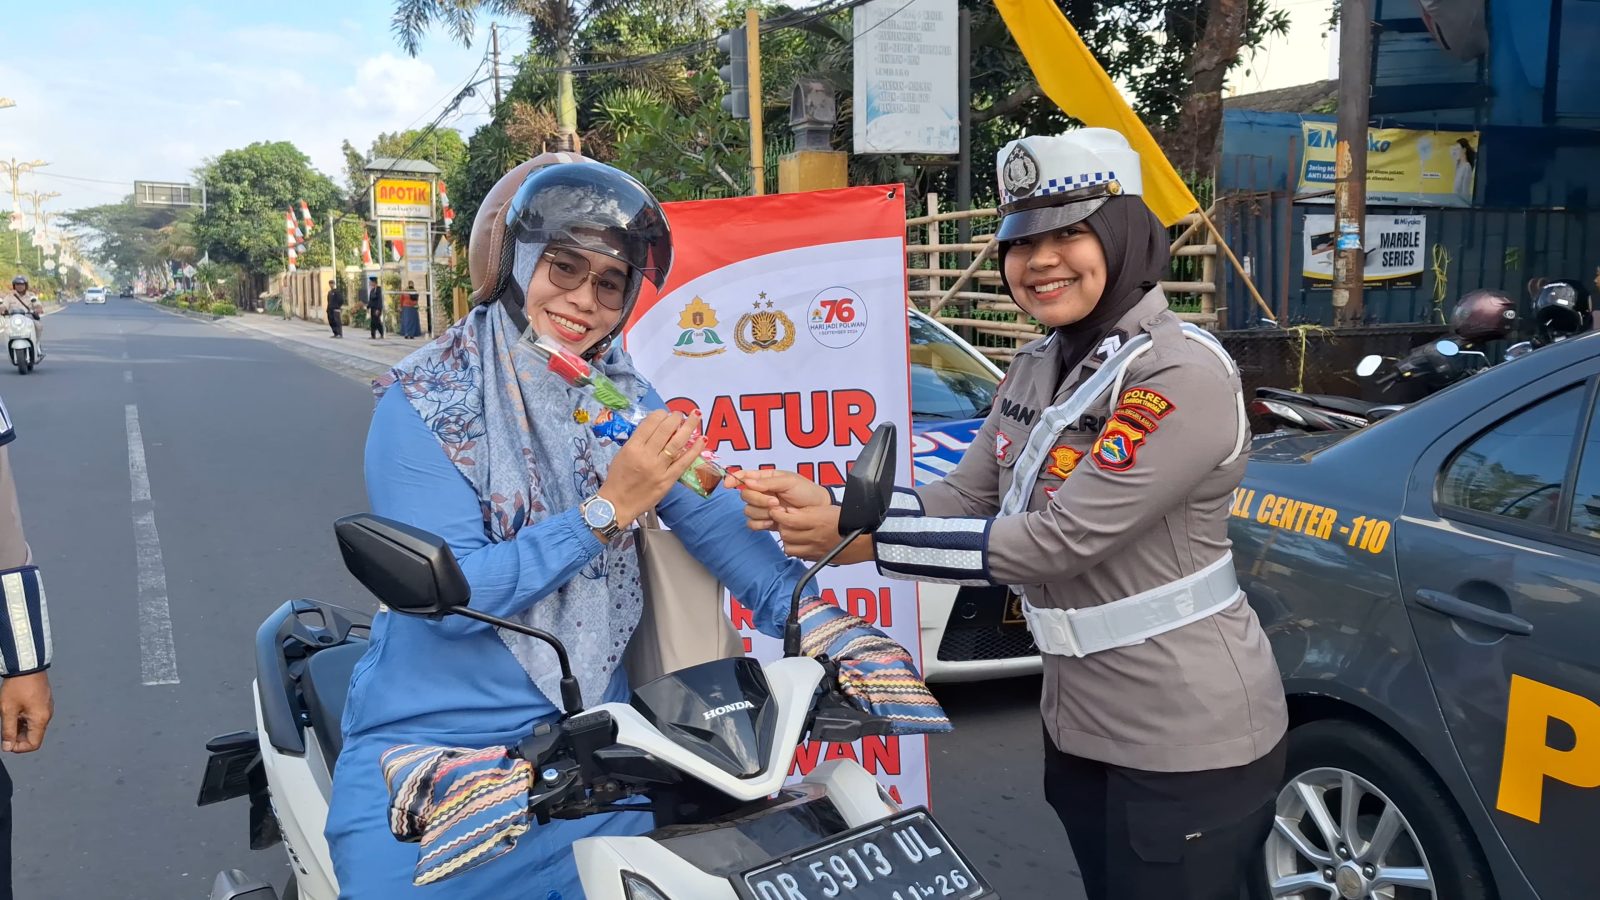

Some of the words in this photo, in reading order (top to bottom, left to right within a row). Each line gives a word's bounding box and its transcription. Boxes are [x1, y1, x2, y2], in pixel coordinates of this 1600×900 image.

[379, 185, 427, 202] APOTIK
[1400, 219, 1421, 227] Miyako
[1380, 232, 1419, 249] MARBLE
[1382, 251, 1414, 267] SERIES
[820, 298, 855, 323] 76
[825, 322, 838, 330] JADI
[1124, 390, 1168, 410] POLRES
[1256, 494, 1337, 540] CENTER
[702, 699, 755, 721] HONDA
[809, 842, 893, 898] 5913
[893, 825, 942, 863] UL
